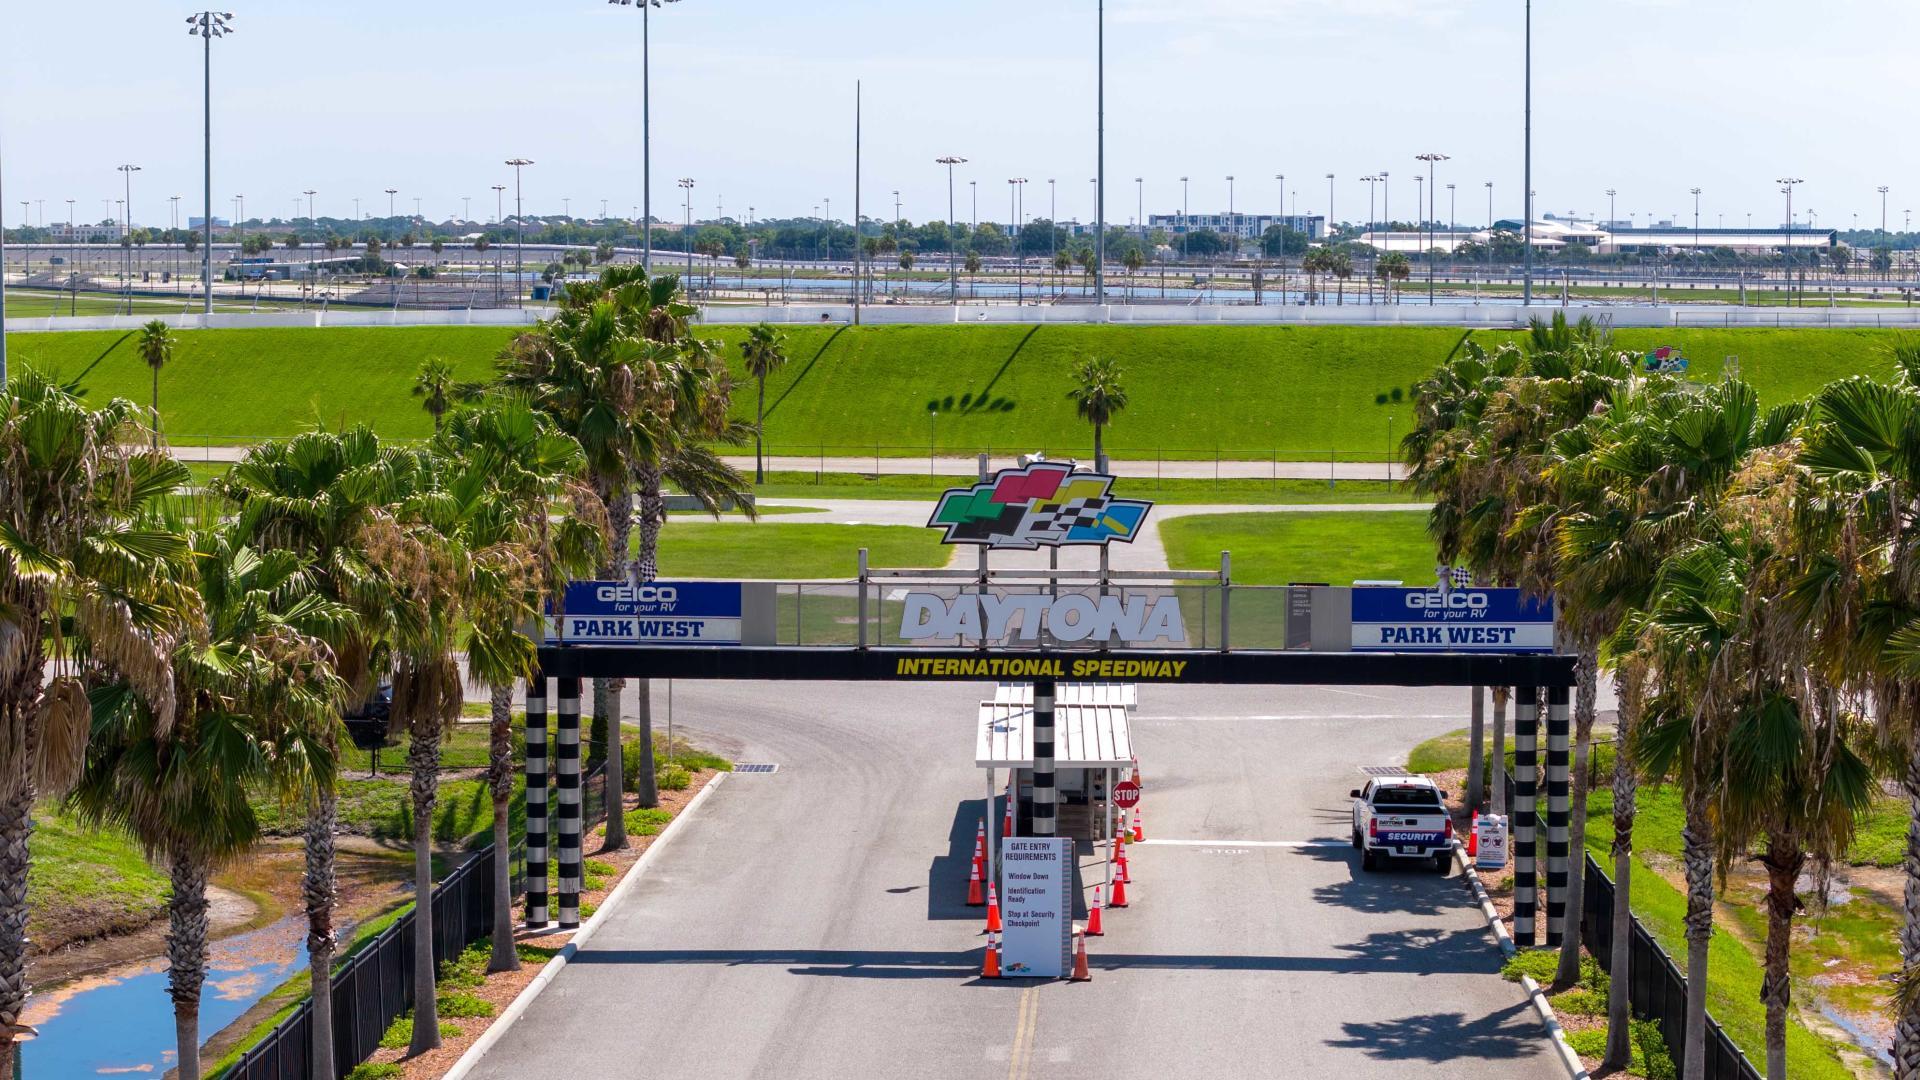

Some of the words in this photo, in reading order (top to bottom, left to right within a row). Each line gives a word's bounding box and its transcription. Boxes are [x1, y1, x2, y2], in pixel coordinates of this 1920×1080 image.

[597, 586, 677, 602] GEICO
[1405, 592, 1488, 609] GEICO
[614, 602, 630, 612] for
[633, 604, 657, 614] your
[659, 602, 676, 612] RV
[1423, 608, 1440, 618] for
[1443, 610, 1467, 620] your
[1470, 608, 1487, 618] RV
[900, 592, 1185, 642] DAYTONA
[573, 620, 632, 637] PARK
[639, 621, 704, 638] WEST
[1380, 627, 1442, 644] PARK
[1448, 627, 1516, 644] WEST
[896, 658, 1065, 677] INTERNATIONAL
[1072, 660, 1187, 678] SPEEDWAY
[1114, 789, 1139, 801] STOP
[1011, 842, 1028, 850] GATE
[1030, 842, 1050, 850] ENTRY
[1006, 852, 1056, 861] REQUIREMENTS
[1008, 896, 1026, 904] Ready
[1008, 910, 1022, 919] Stop
[1030, 910, 1055, 919] Security
